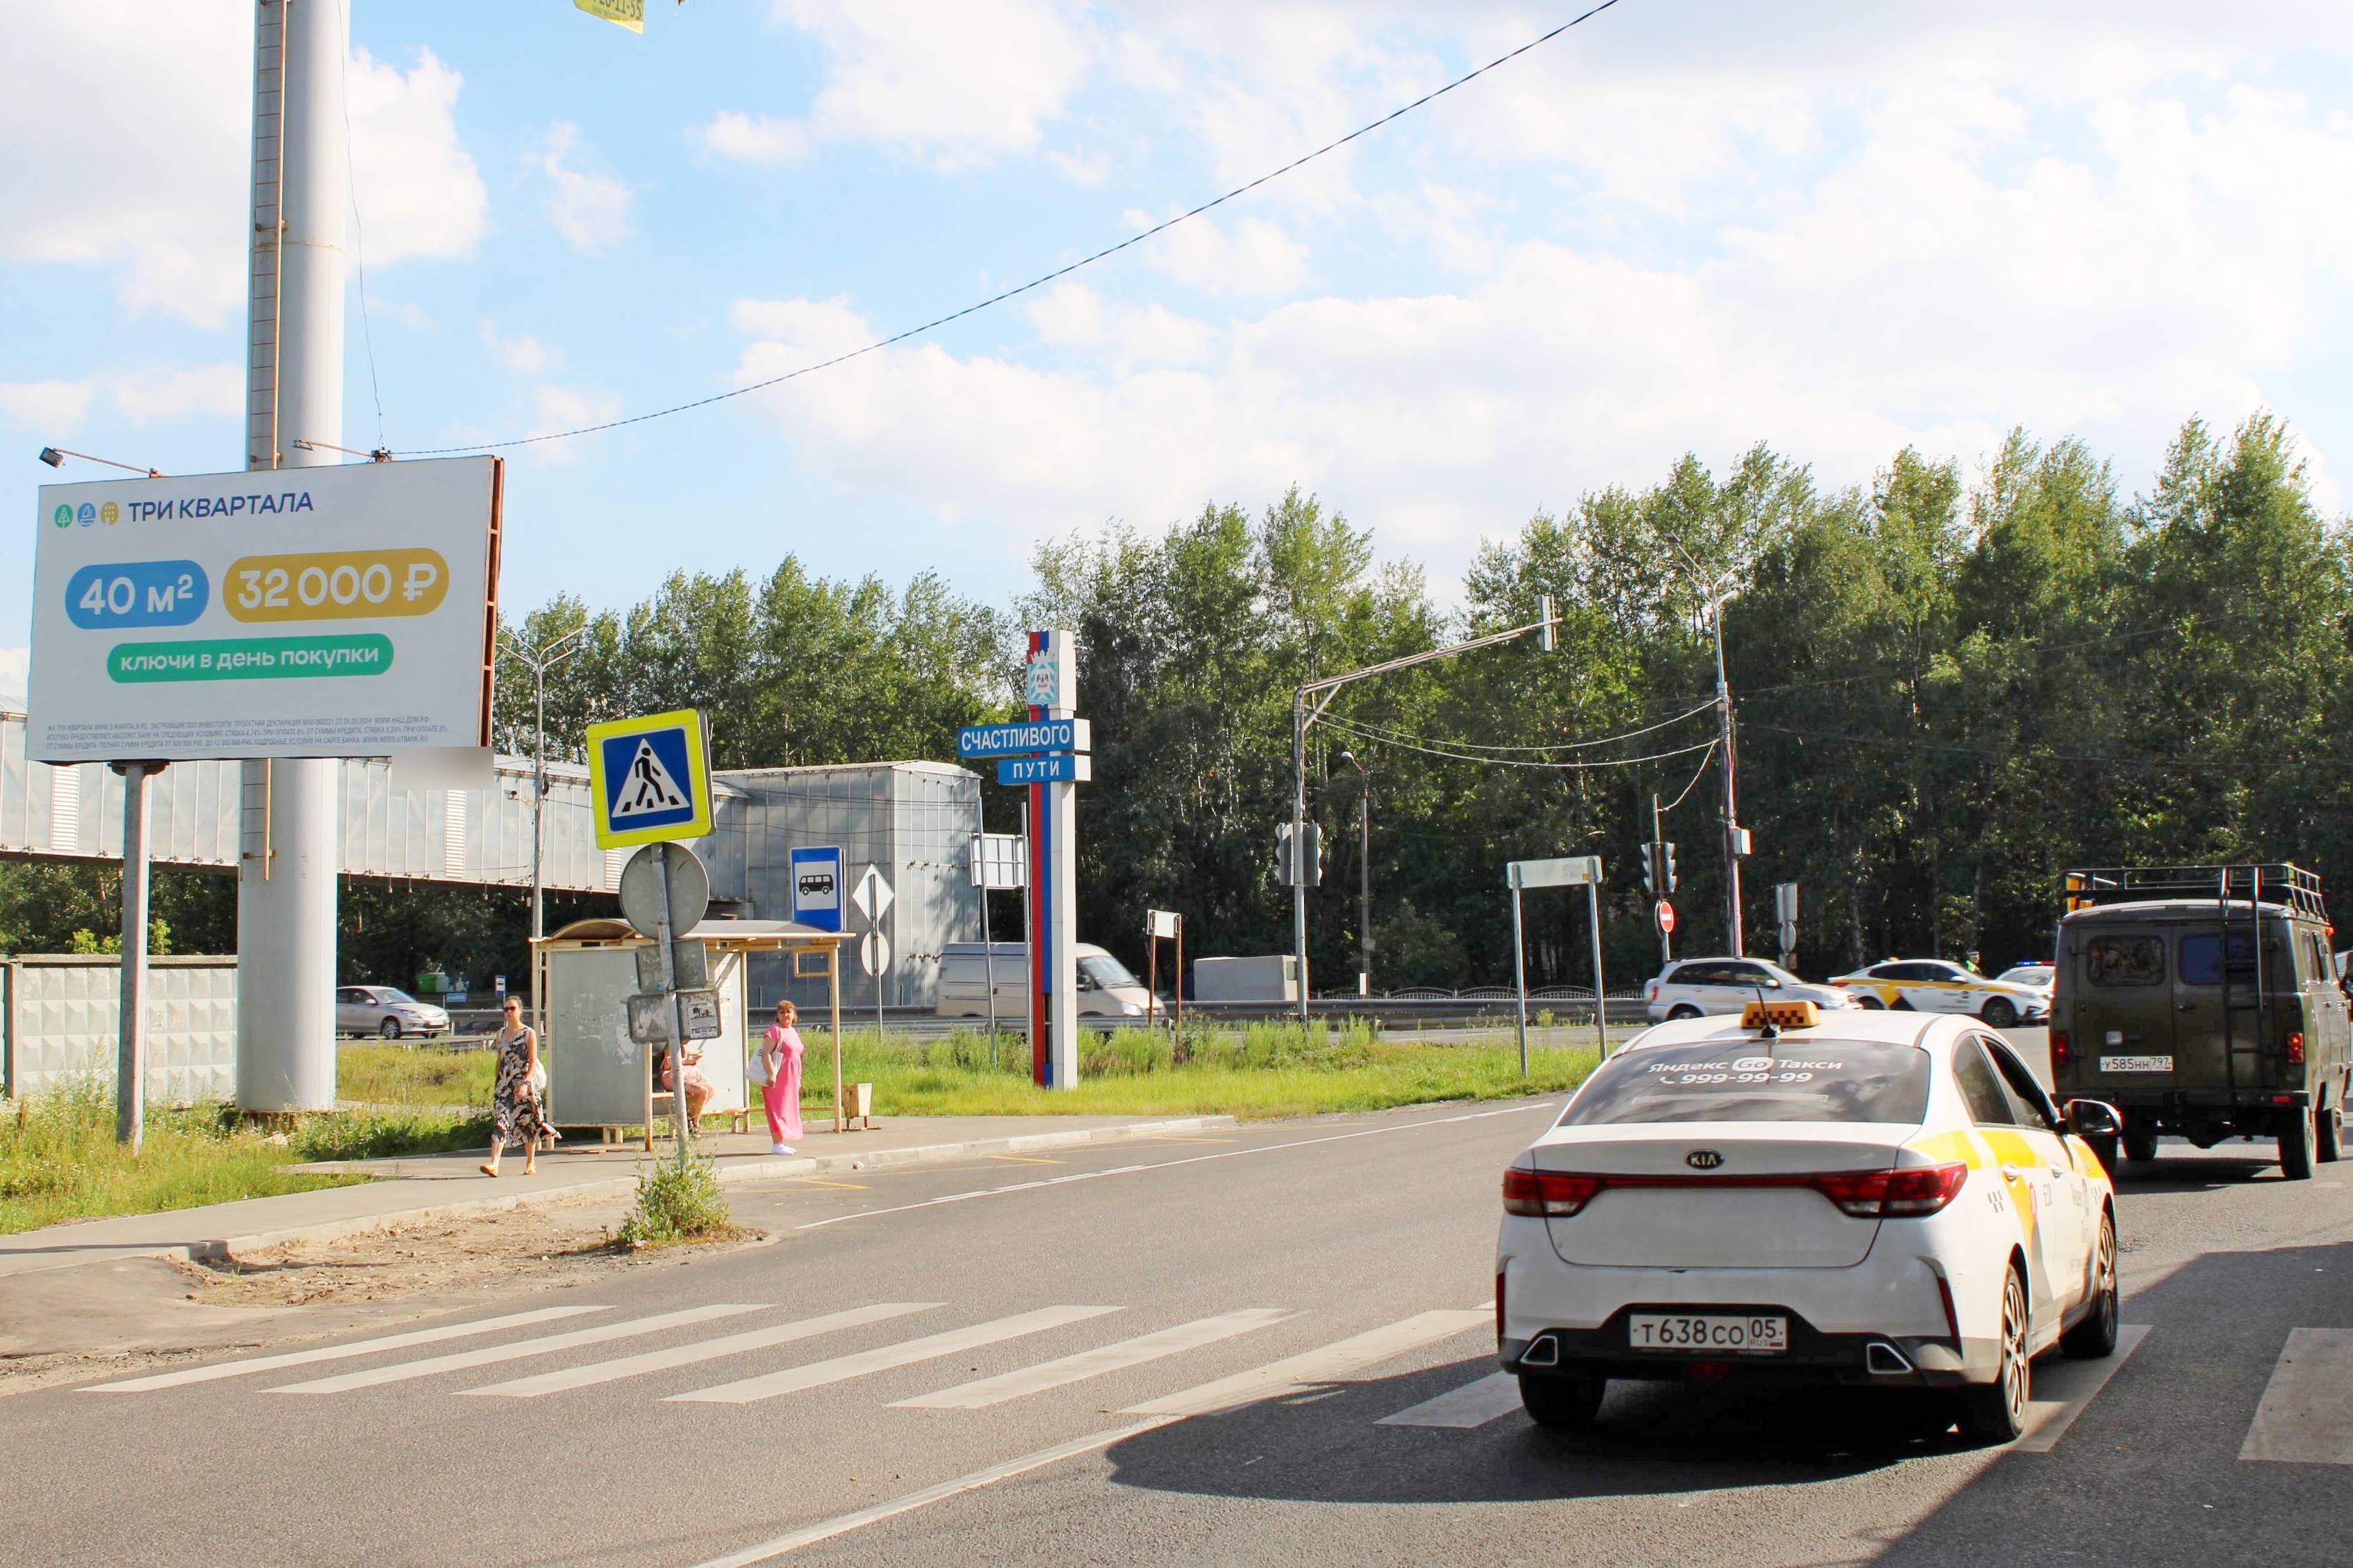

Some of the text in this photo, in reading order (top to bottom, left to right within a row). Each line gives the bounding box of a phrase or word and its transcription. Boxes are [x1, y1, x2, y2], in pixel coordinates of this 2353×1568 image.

[129, 491, 314, 522] ТРИ КВАРТАЛА
[79, 576, 136, 615] 40
[121, 647, 379, 672] ключи в день покупки
[961, 724, 1070, 751] СЧАСТЛИВОГО
[1013, 760, 1060, 779] ПУТИ
[1647, 1061, 1728, 1073] Яндекс
[1778, 1059, 1844, 1070] Такси
[1680, 1072, 1813, 1084] 999-99-99
[1691, 1154, 1717, 1166] KIA
[1751, 1319, 1777, 1339] 05
